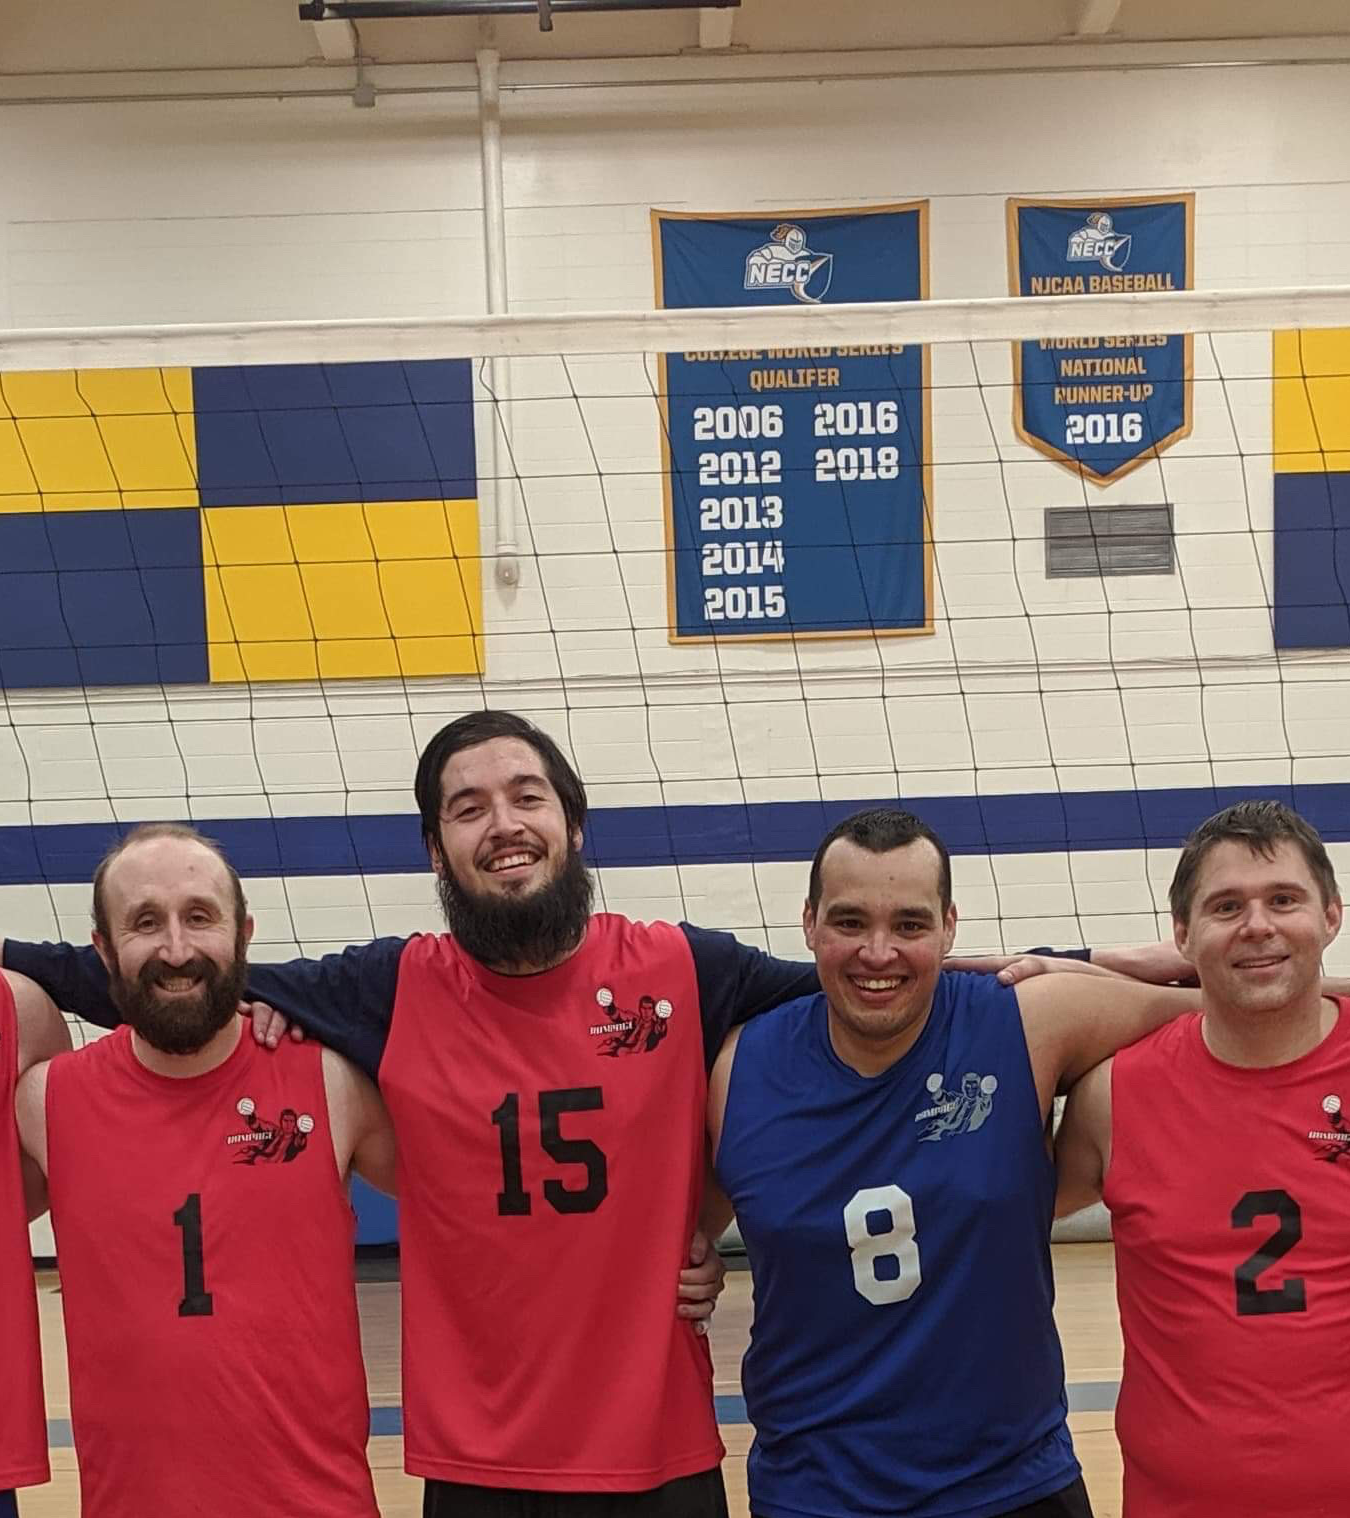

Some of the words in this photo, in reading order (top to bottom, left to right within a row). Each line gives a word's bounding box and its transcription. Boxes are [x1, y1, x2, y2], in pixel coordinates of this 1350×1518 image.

[1071, 241, 1115, 257] NECC
[749, 263, 809, 284] NECC
[1031, 275, 1085, 295] NJCAA
[1089, 272, 1176, 293] BASEBALL
[750, 367, 840, 391] QUALIFER
[1060, 356, 1147, 377] NATIONAL
[1054, 384, 1153, 405] RUNNER-UP
[693, 405, 784, 441] 2006
[814, 401, 899, 437] 2016
[1065, 412, 1143, 445] 2016
[698, 450, 782, 486] 2012
[815, 446, 900, 482] 2018
[699, 495, 784, 531] 2013
[702, 541, 785, 576] 2014
[704, 585, 786, 621] 2015
[491, 1085, 609, 1217] 15
[172, 1193, 214, 1317] 1
[842, 1184, 924, 1306] 8
[1230, 1189, 1308, 1317] 2
